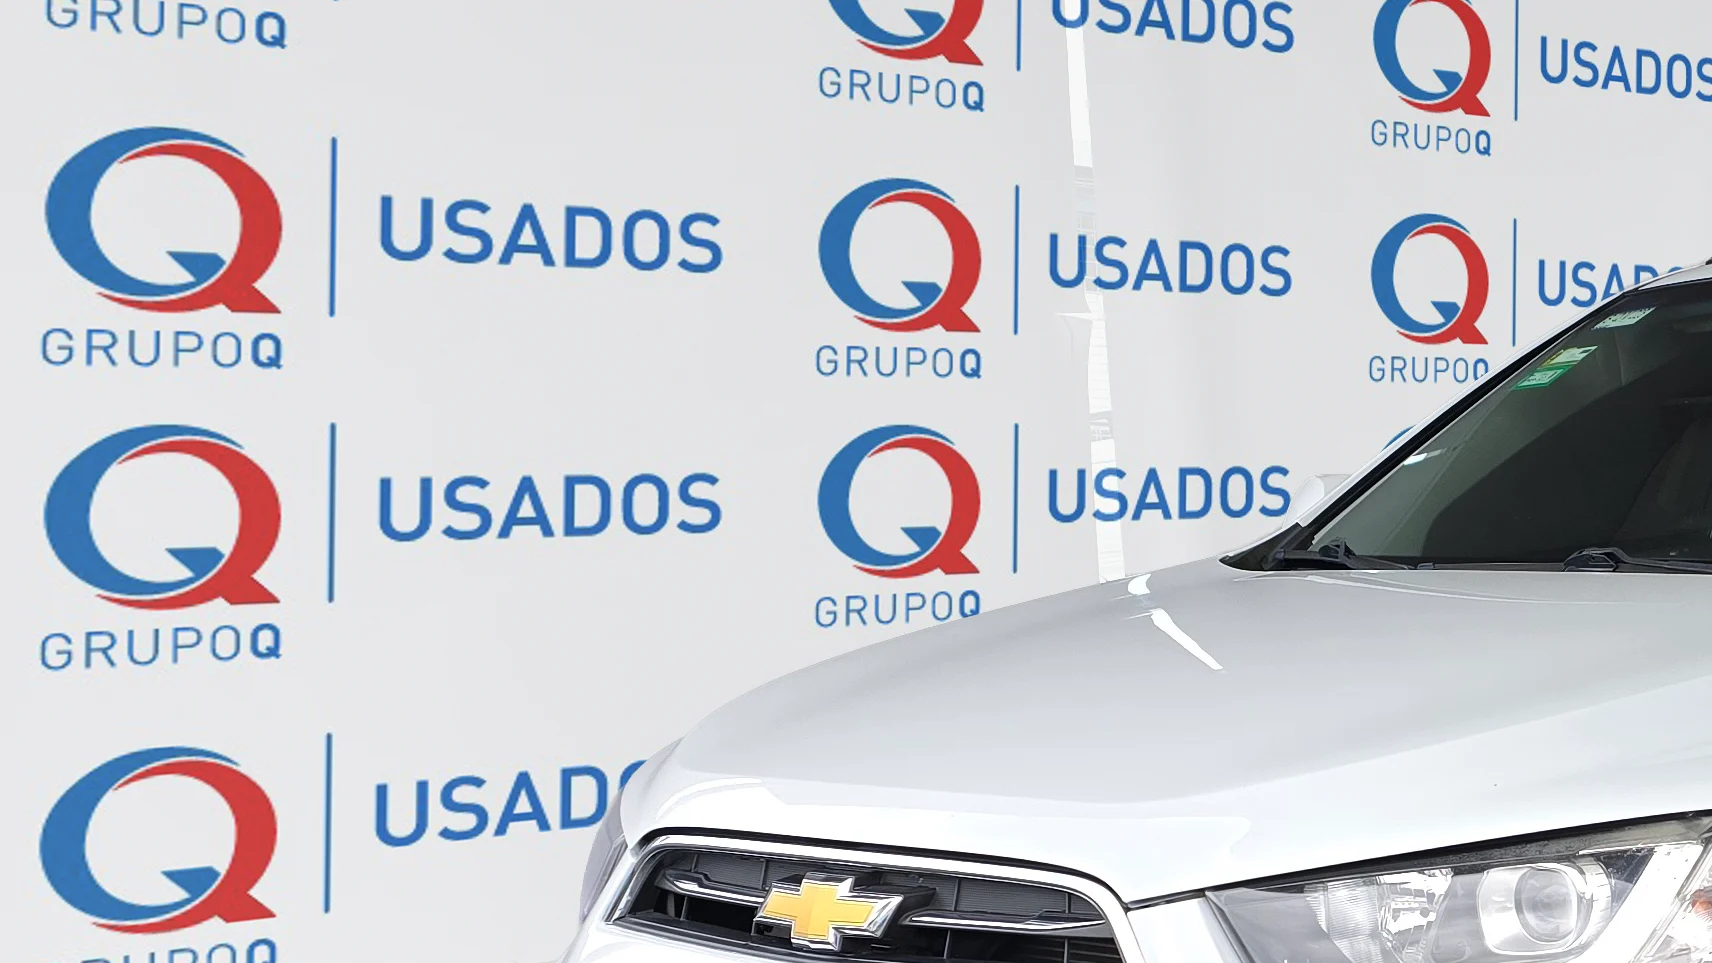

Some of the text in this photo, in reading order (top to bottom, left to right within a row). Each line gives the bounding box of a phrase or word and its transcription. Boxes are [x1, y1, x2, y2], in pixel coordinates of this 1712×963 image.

[45, 0, 287, 49] GRUPOQ
[818, 67, 984, 112] GRUPOQ
[1372, 120, 1491, 157] GRUPOQ
[380, 195, 723, 273] USADOS
[1049, 233, 1293, 297] USADOS
[1538, 259, 1681, 308] USA
[40, 328, 283, 369] GRUPOQ
[815, 346, 982, 379] GRUPOQ
[378, 473, 722, 542] USADOS
[1048, 466, 1291, 523] USADOS
[815, 590, 981, 628] GRUPOQ
[41, 623, 281, 671] GRUPOQ
[374, 760, 646, 848] USAD
